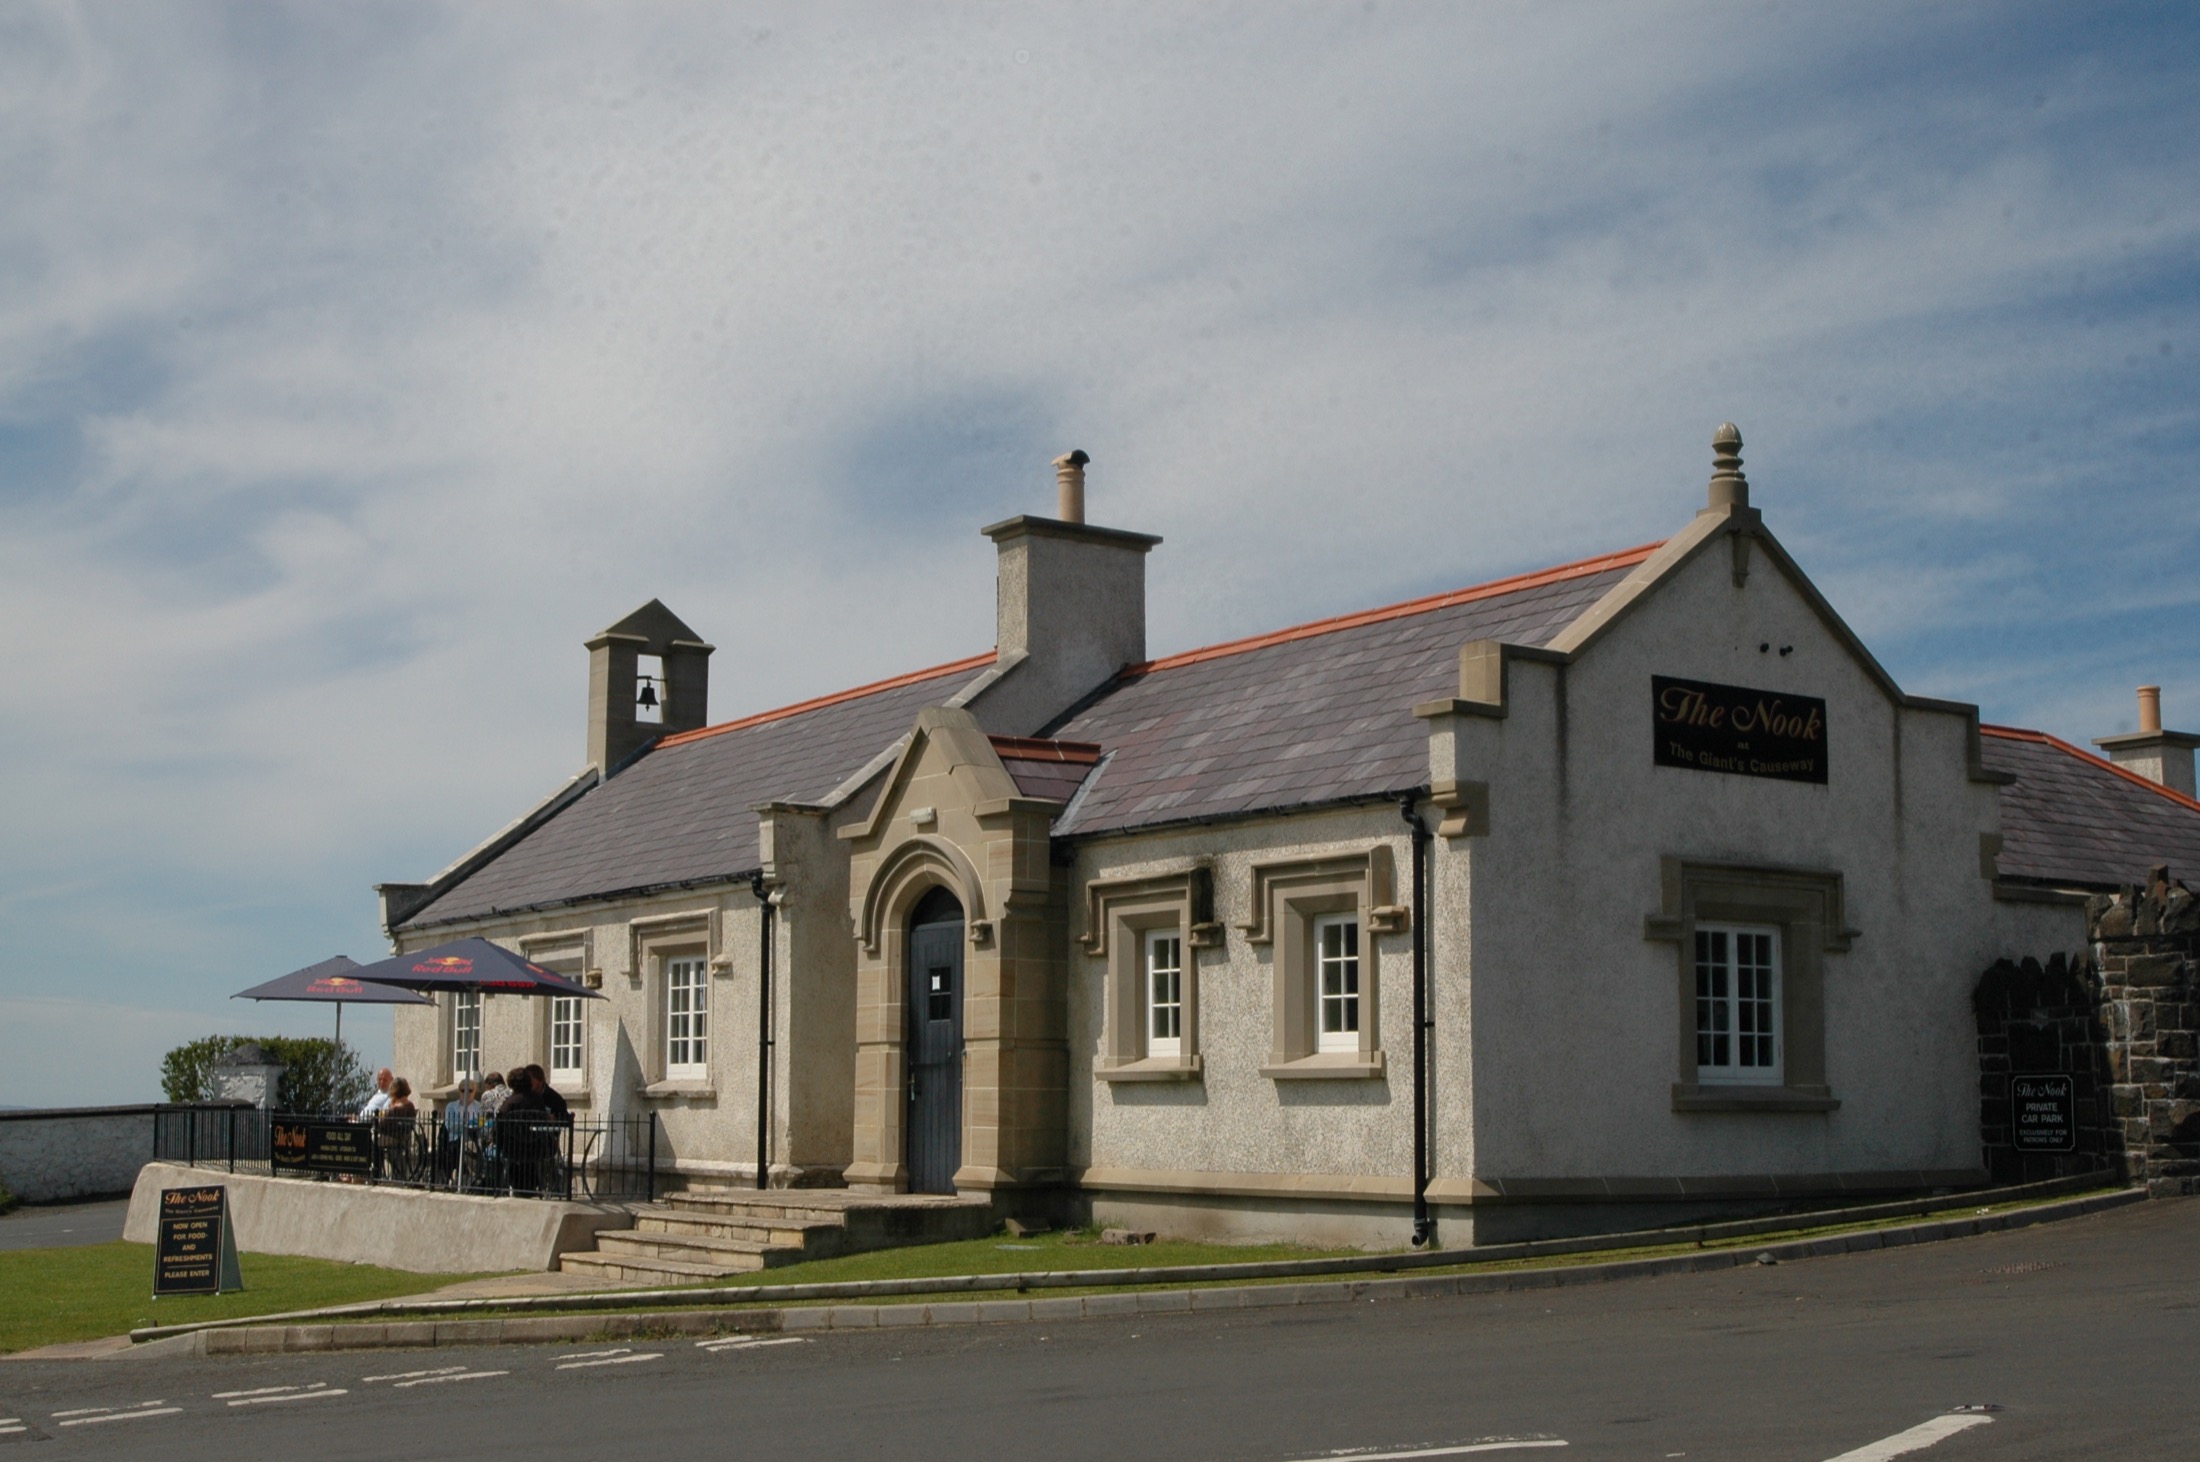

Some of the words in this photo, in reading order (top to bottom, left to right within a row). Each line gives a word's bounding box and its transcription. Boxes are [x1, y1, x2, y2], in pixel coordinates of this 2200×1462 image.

[1660, 686, 1725, 728] The
[1731, 699, 1821, 740] Nook
[1737, 741, 1750, 750] at
[1670, 741, 1693, 761] The
[1699, 751, 1745, 771] Giant's
[1750, 757, 1814, 773] Causeway
[2016, 1082, 2036, 1097] The
[2037, 1081, 2067, 1097] Nook
[2025, 1102, 2058, 1112] PRIVATE
[2021, 1114, 2038, 1123] CAR
[2041, 1114, 2063, 1123] PARK
[165, 1191, 186, 1205] The
[188, 1189, 219, 1203] Nook
[163, 1253, 213, 1262] REFRESHMENTS
[164, 1270, 187, 1278] PLEASE
